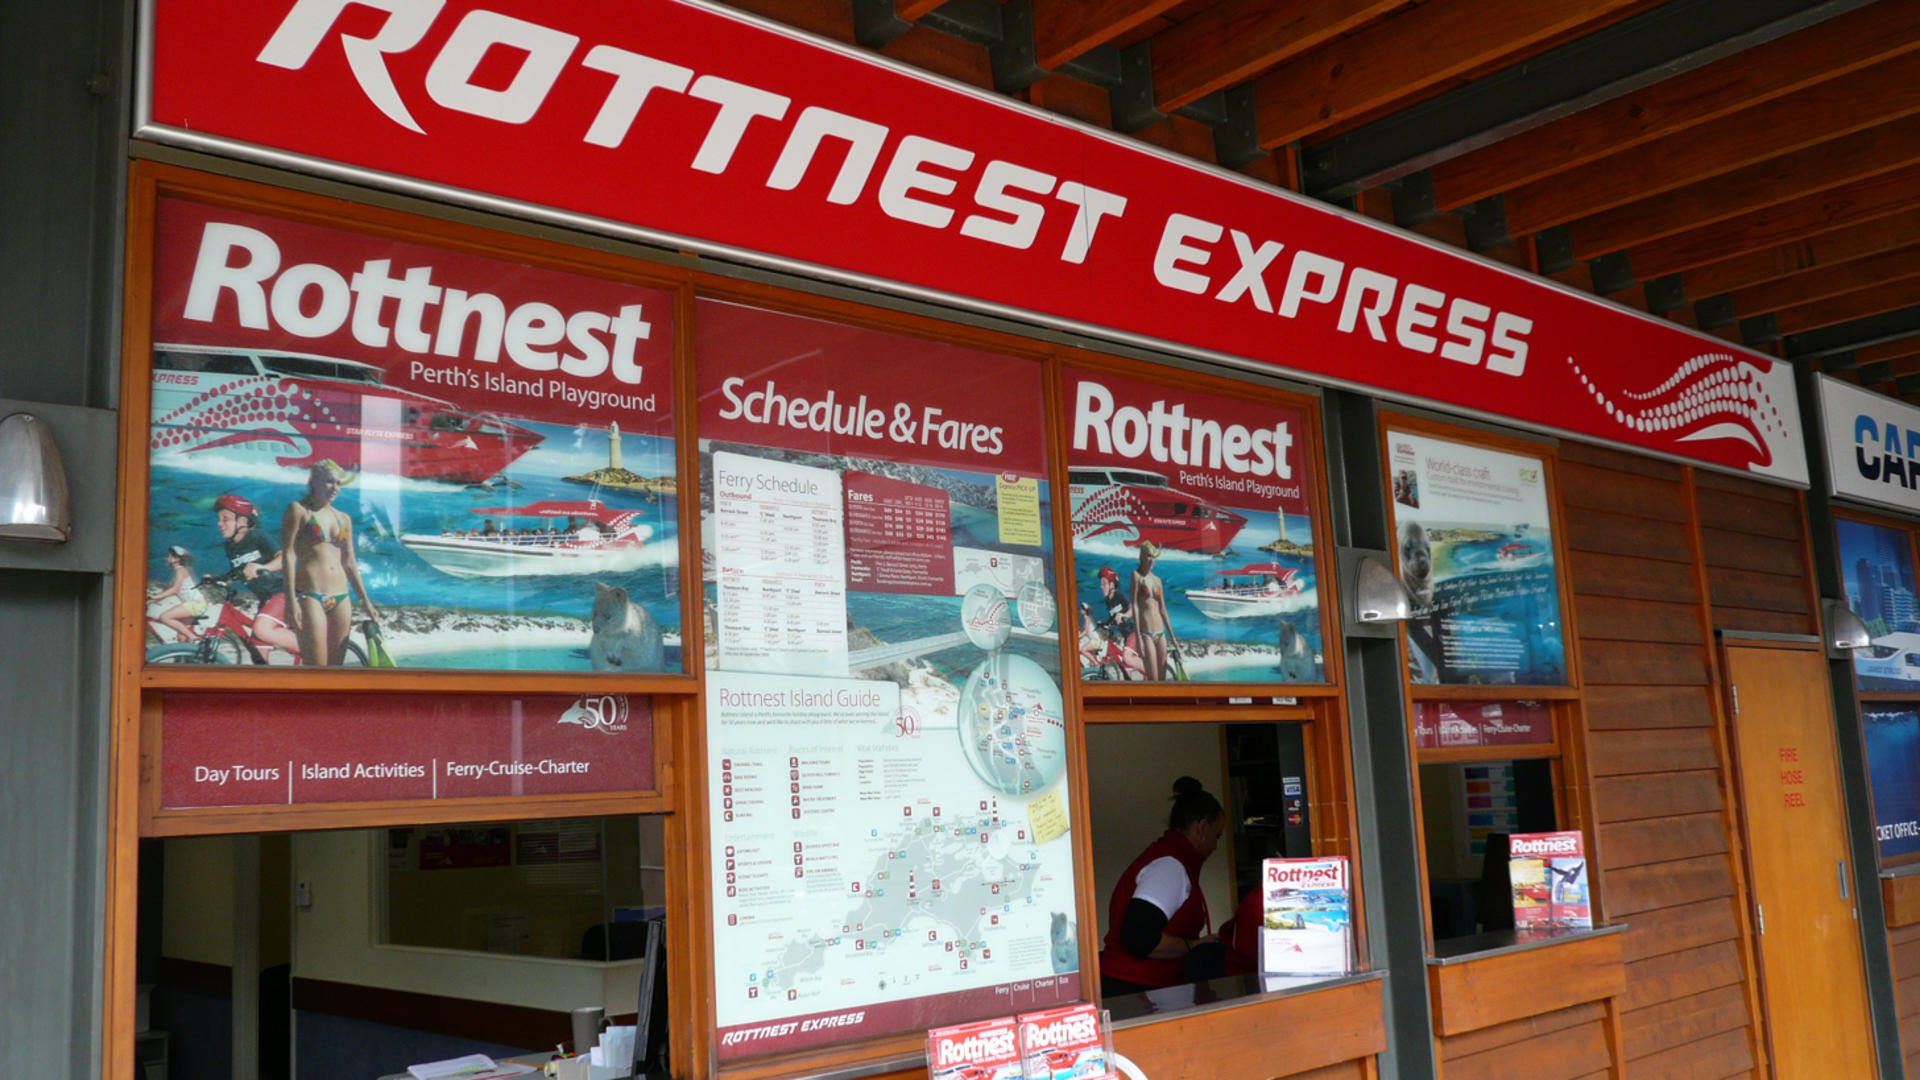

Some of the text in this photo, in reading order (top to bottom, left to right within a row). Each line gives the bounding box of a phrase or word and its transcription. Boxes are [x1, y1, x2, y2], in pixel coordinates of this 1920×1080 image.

[256, 0, 1534, 377] ROTTNEST EXPRESS
[183, 222, 651, 385] Rottnest
[410, 361, 656, 413] Perth's Island Playground
[720, 377, 1004, 455] Schedule & Fares
[1073, 381, 1293, 480] Rottnest
[719, 470, 819, 496] Ferry Schedule
[847, 489, 874, 502] Fares
[1180, 470, 1300, 499] Perth's Island Playground
[584, 695, 617, 729] 50
[719, 688, 881, 708] Rottnest Island Guide
[896, 715, 915, 738] 50
[1778, 748, 1799, 763] FIRE
[194, 759, 591, 787] Day Tours Island Activities Ferry-Cruise-Charter
[1782, 770, 1805, 785] HOSE
[1784, 792, 1806, 808] REEL
[1510, 838, 1577, 853] Rottnest
[1267, 865, 1339, 883] Rottnest
[994, 986, 1010, 995] Ferry
[1034, 979, 1055, 989] Charter
[722, 1012, 865, 1046] ROTTNEST EXPRESS
[1027, 1015, 1096, 1048] Rottnest
[939, 1030, 1016, 1065] Rottnest
